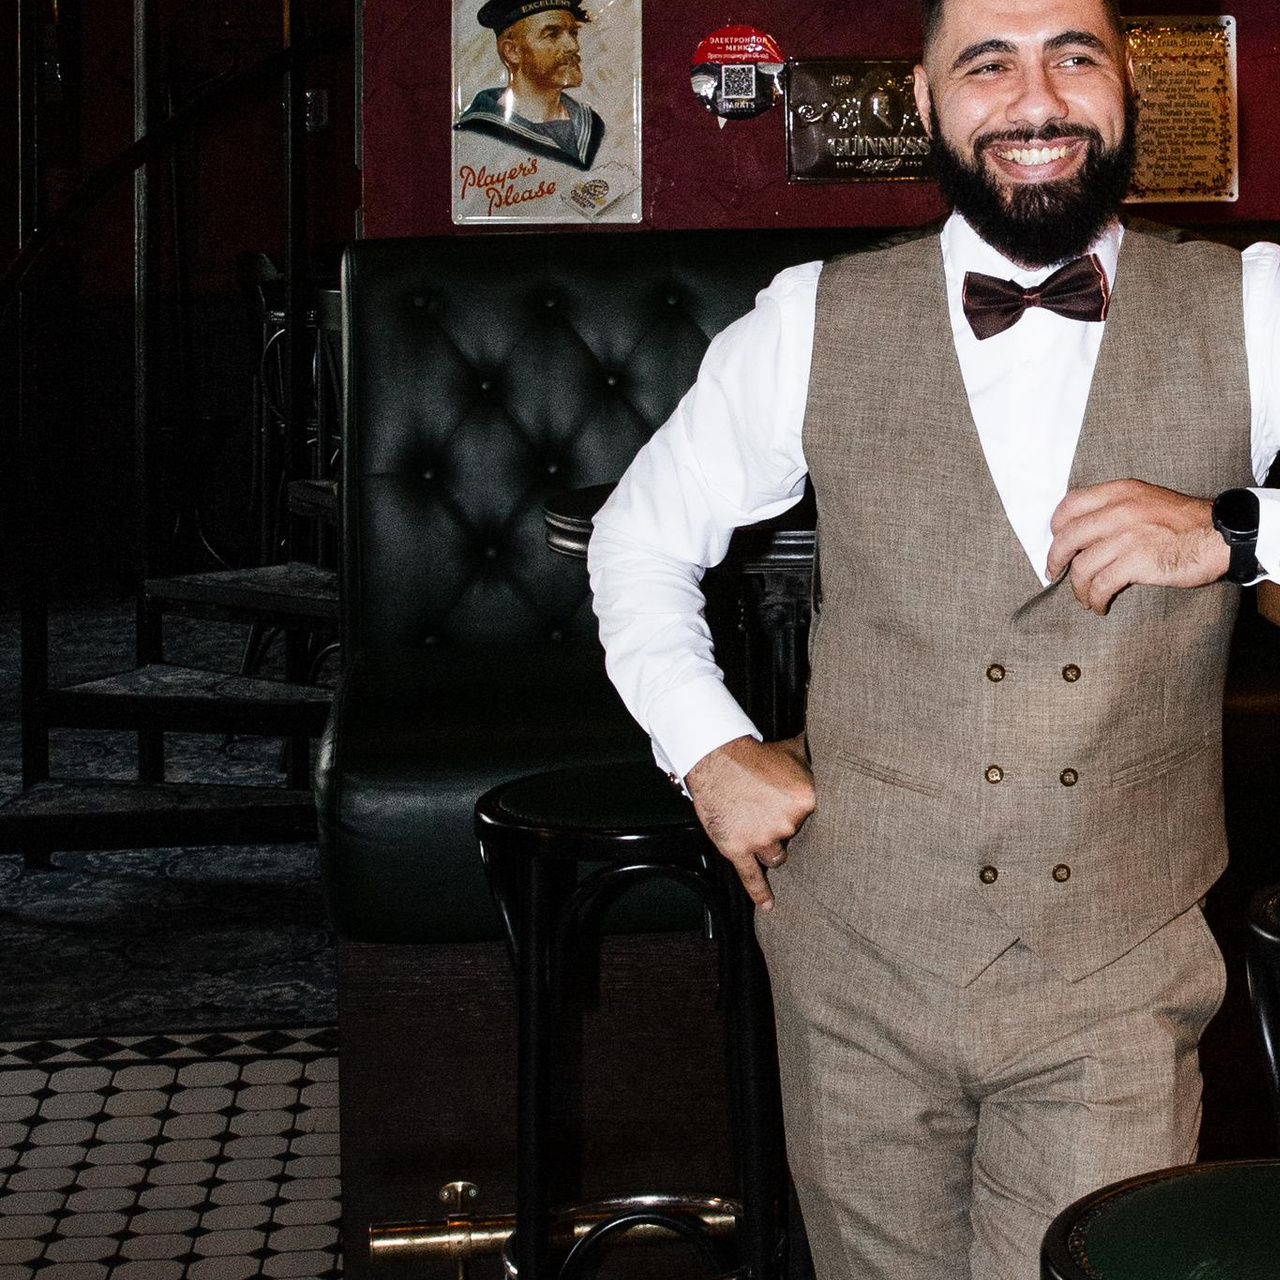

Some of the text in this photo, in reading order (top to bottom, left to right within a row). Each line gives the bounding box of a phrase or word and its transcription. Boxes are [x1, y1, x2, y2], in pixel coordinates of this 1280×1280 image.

[828, 136, 931, 157] GUINNESS
[459, 157, 539, 200] Player's
[486, 180, 557, 217] Please
